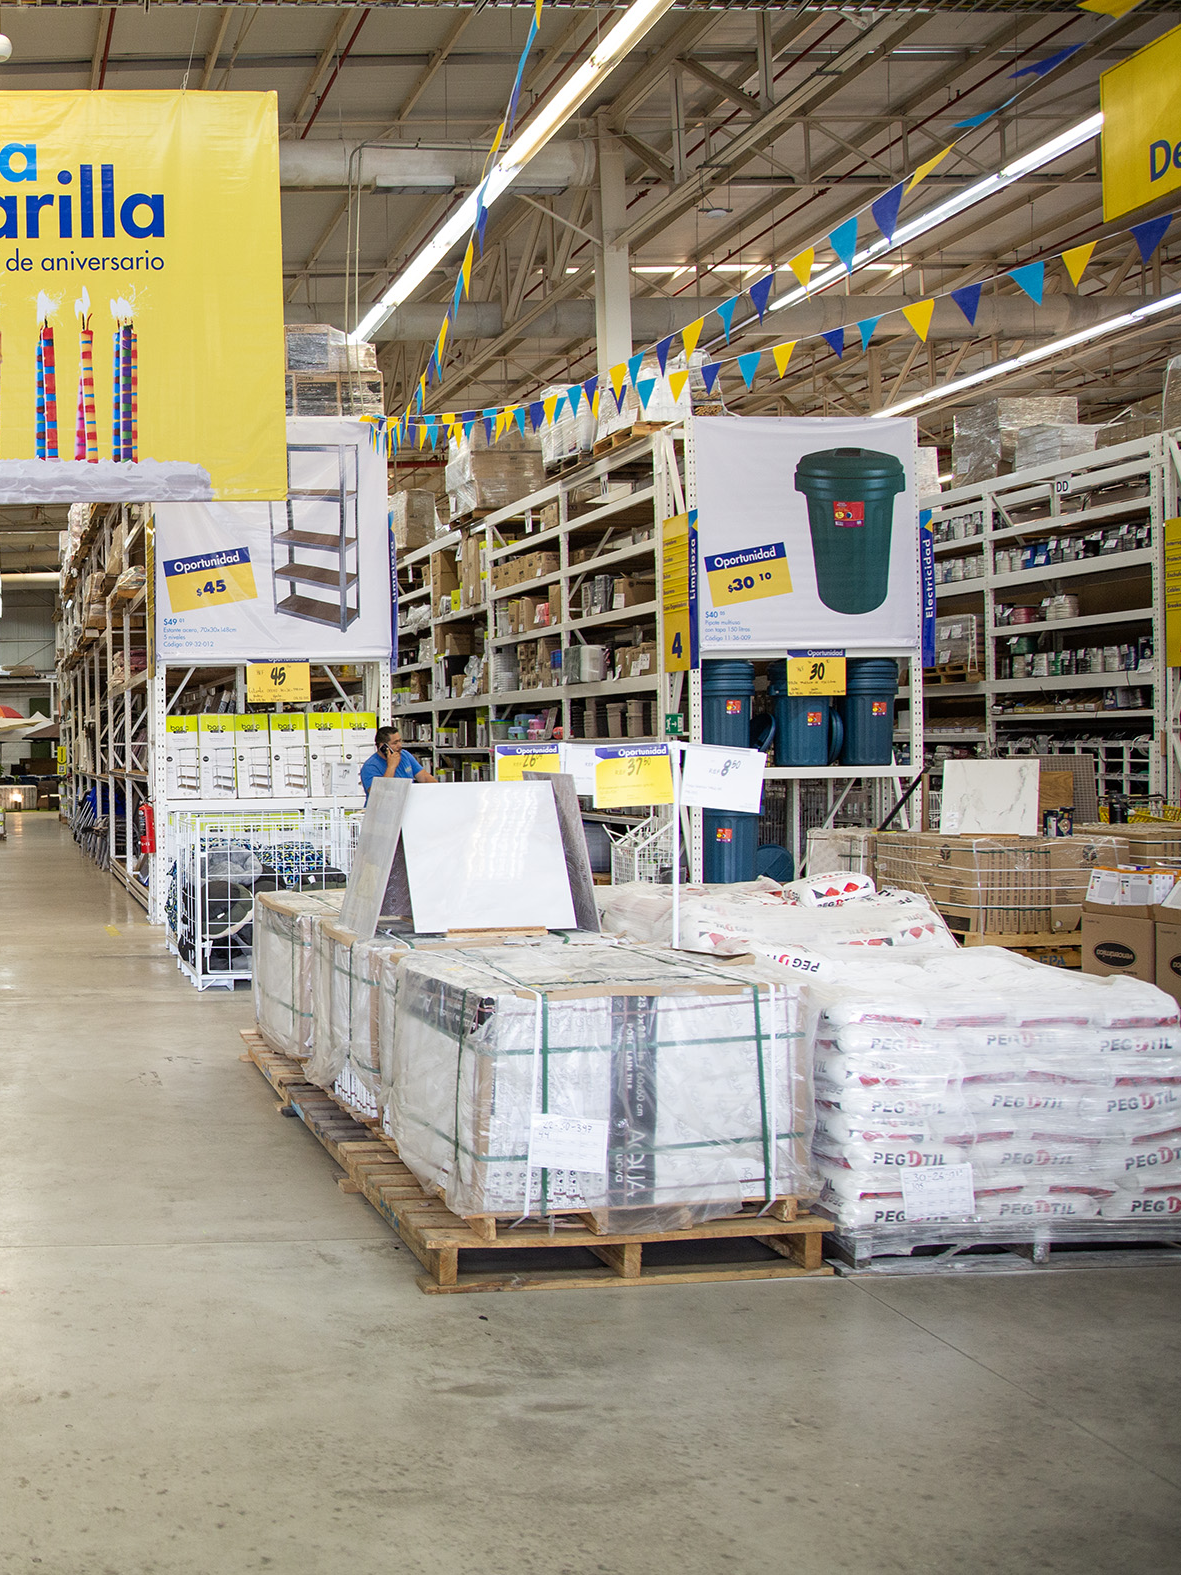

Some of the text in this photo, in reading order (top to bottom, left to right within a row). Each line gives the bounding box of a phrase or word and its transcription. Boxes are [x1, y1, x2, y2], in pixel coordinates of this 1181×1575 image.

[5, 249, 34, 273] de
[41, 252, 165, 273] aniversario
[1056, 480, 1069, 493] DD
[174, 551, 241, 574] Oportunidad
[714, 546, 777, 569] Oportunidad
[728, 572, 772, 593] $30 10
[924, 538, 934, 619] Electricidad
[196, 579, 227, 597] $45
[163, 618, 178, 626] $49
[705, 611, 718, 619] $40
[672, 631, 683, 659] 4
[807, 649, 844, 658] Oportunidad
[270, 666, 286, 686] 45
[809, 662, 825, 680] 30
[516, 746, 558, 755] Oportunidad
[618, 747, 667, 759] Oportunidad
[523, 754, 536, 768] 26
[627, 757, 643, 776] 37
[721, 759, 732, 777] 8
[635, 1072, 646, 1102] 60x60
[635, 1103, 645, 1117] cm
